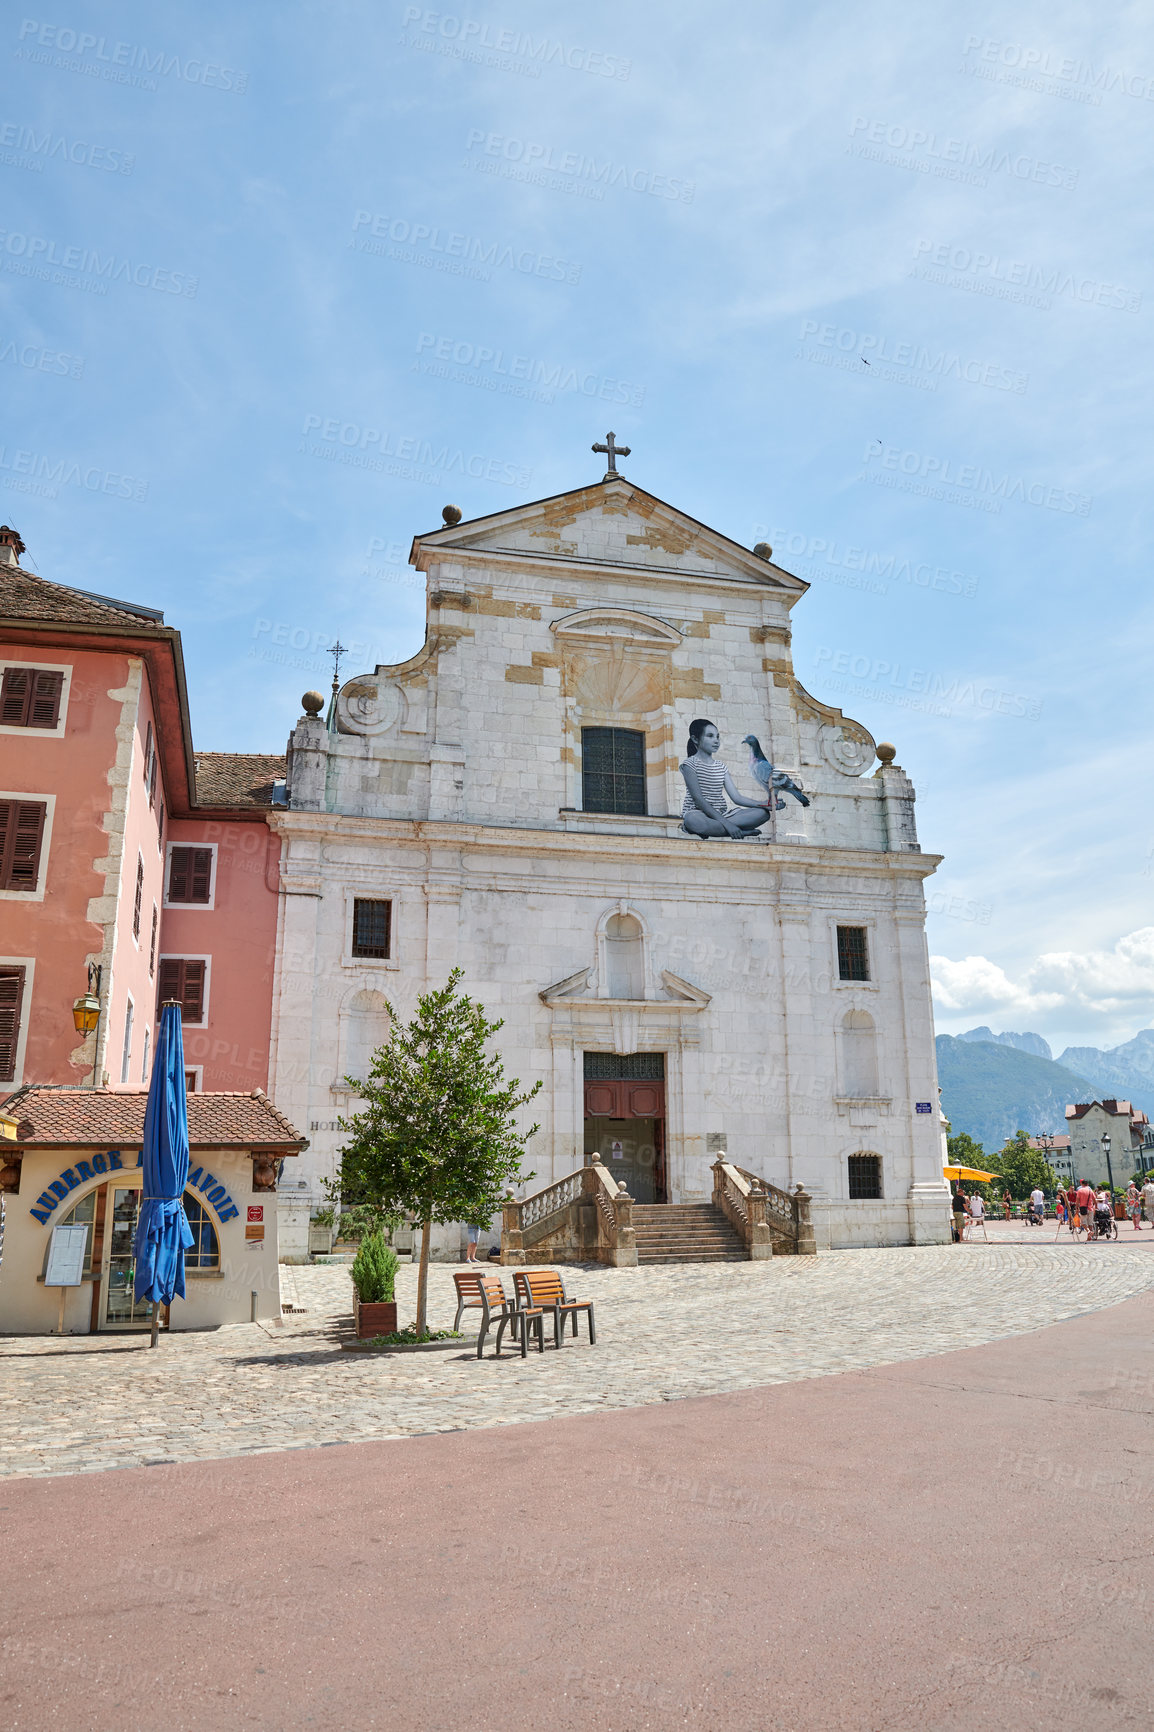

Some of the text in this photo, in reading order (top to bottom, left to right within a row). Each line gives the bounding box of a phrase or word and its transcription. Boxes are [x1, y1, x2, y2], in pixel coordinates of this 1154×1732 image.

[310, 1121, 346, 1131] HOTE
[29, 1150, 123, 1226] AUBERGE
[187, 1161, 240, 1224] AVOIE
